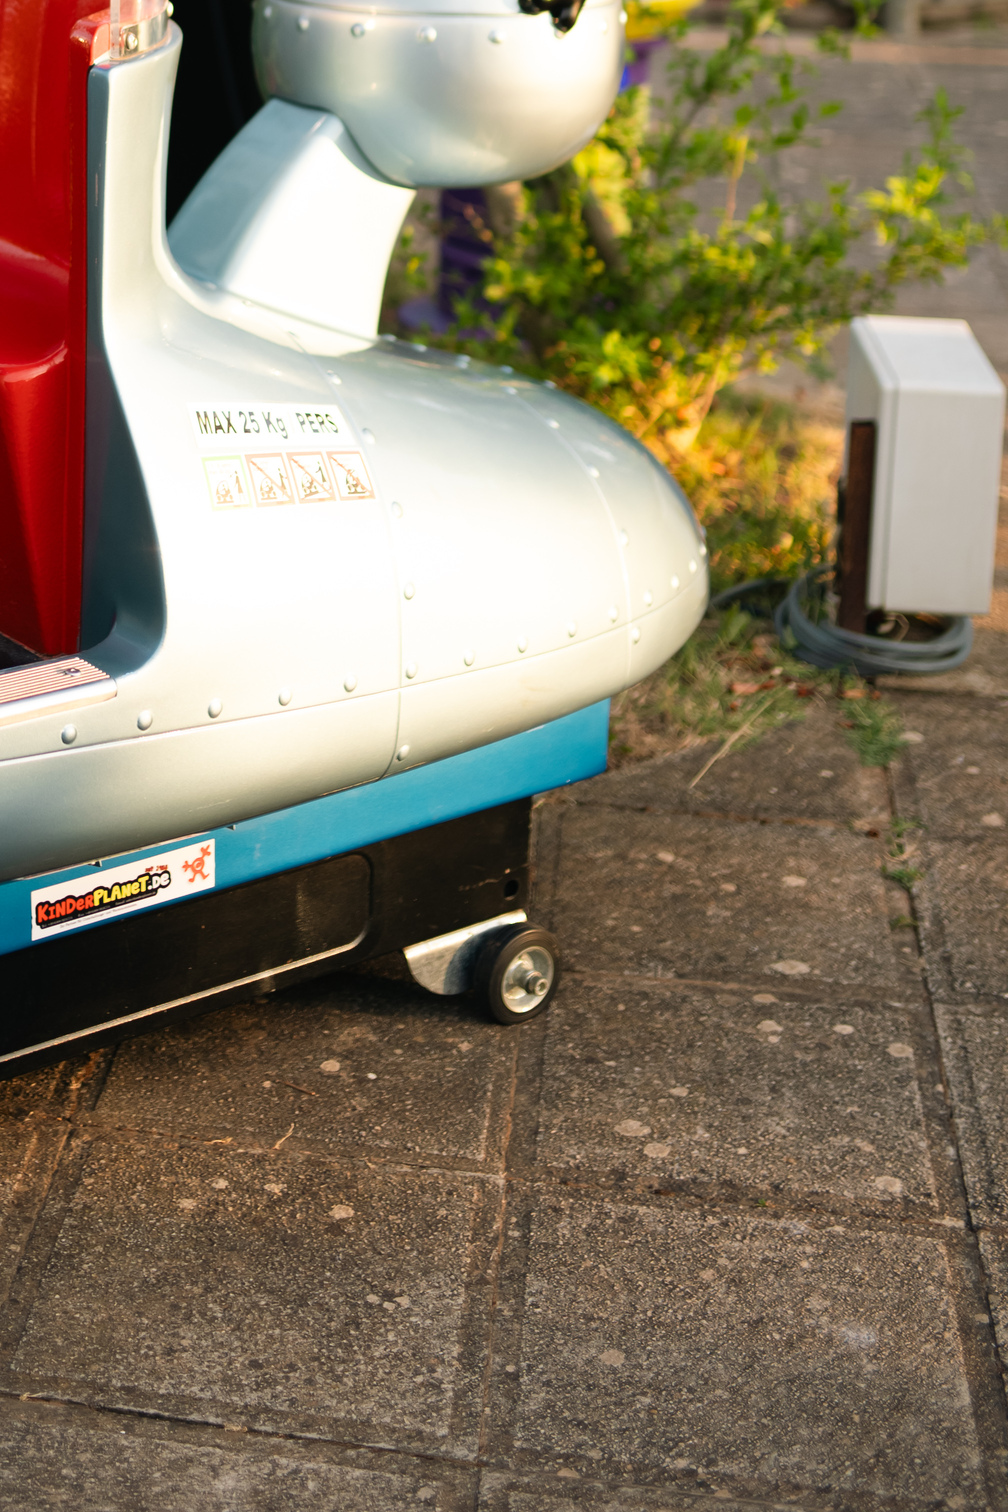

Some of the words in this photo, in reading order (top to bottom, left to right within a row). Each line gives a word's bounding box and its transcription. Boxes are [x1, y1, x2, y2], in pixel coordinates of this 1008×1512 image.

[195, 410, 237, 434] MAX
[238, 410, 260, 434] 25
[261, 410, 289, 440] Kg
[295, 412, 339, 434] PERS
